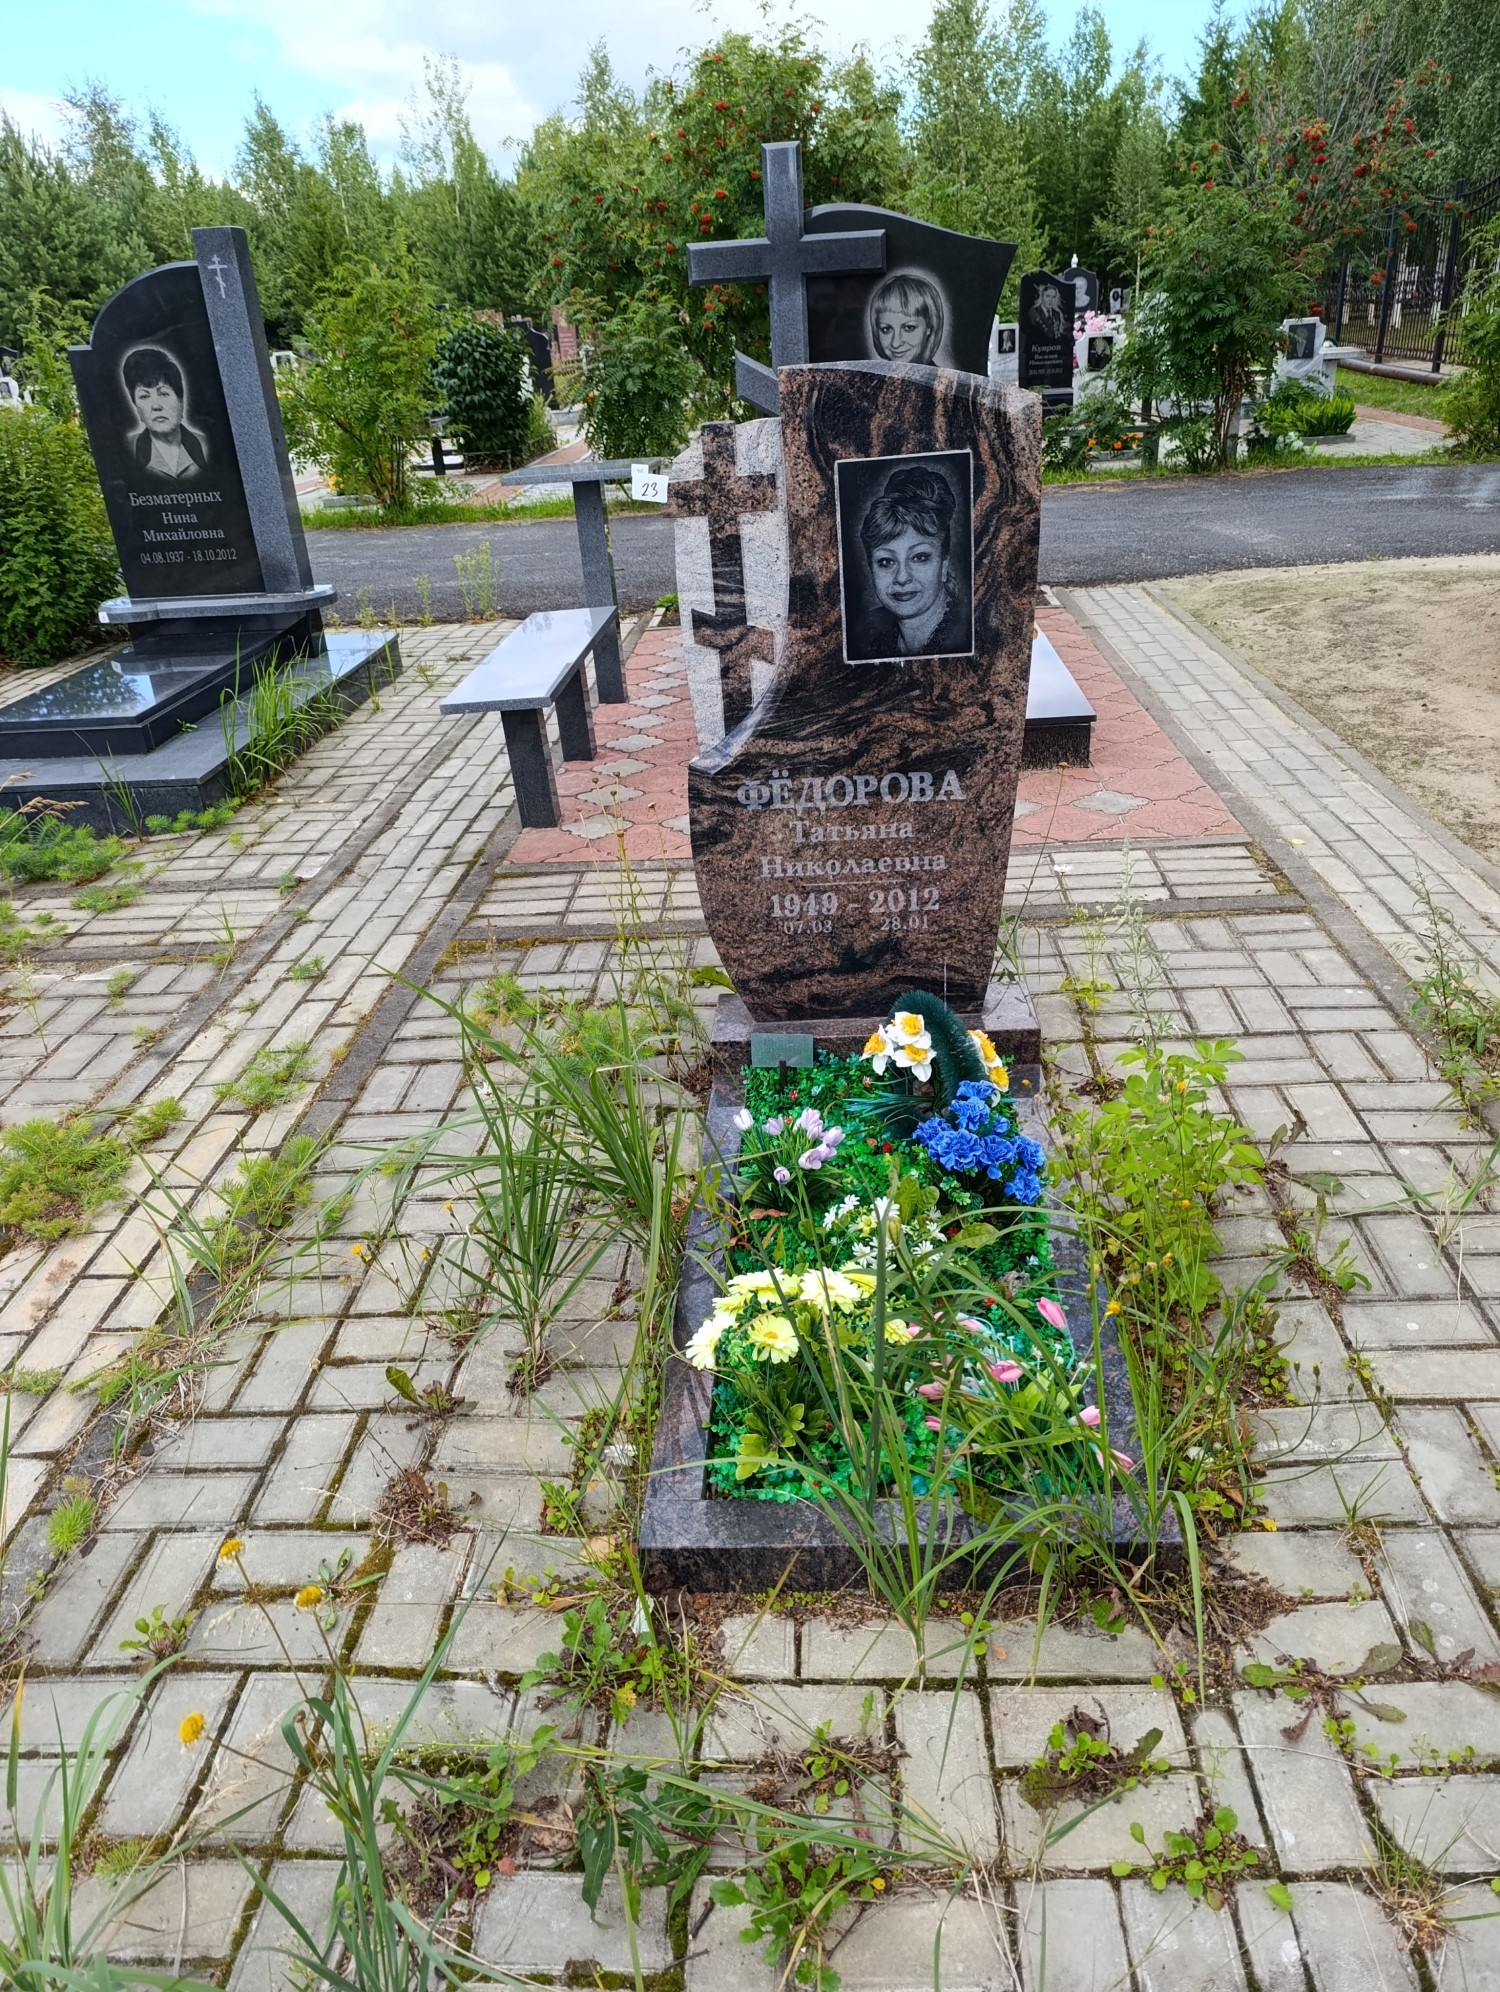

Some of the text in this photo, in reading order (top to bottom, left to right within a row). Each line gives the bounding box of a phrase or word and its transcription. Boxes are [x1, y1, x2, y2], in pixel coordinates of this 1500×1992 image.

[641, 482, 659, 498] 23
[128, 491, 222, 507] Безматерных
[161, 512, 198, 524] Нина
[142, 528, 225, 542] Михайловна
[140, 551, 184, 565] 04.08.1937
[192, 548, 238, 562] 18.10.2012
[736, 769, 967, 816] ФЁДОРОВА
[789, 821, 915, 843] Татьяна
[760, 854, 949, 879] Николаевна
[770, 892, 839, 918] 1949
[868, 887, 940, 913] 2012
[880, 915, 930, 931] 28.01
